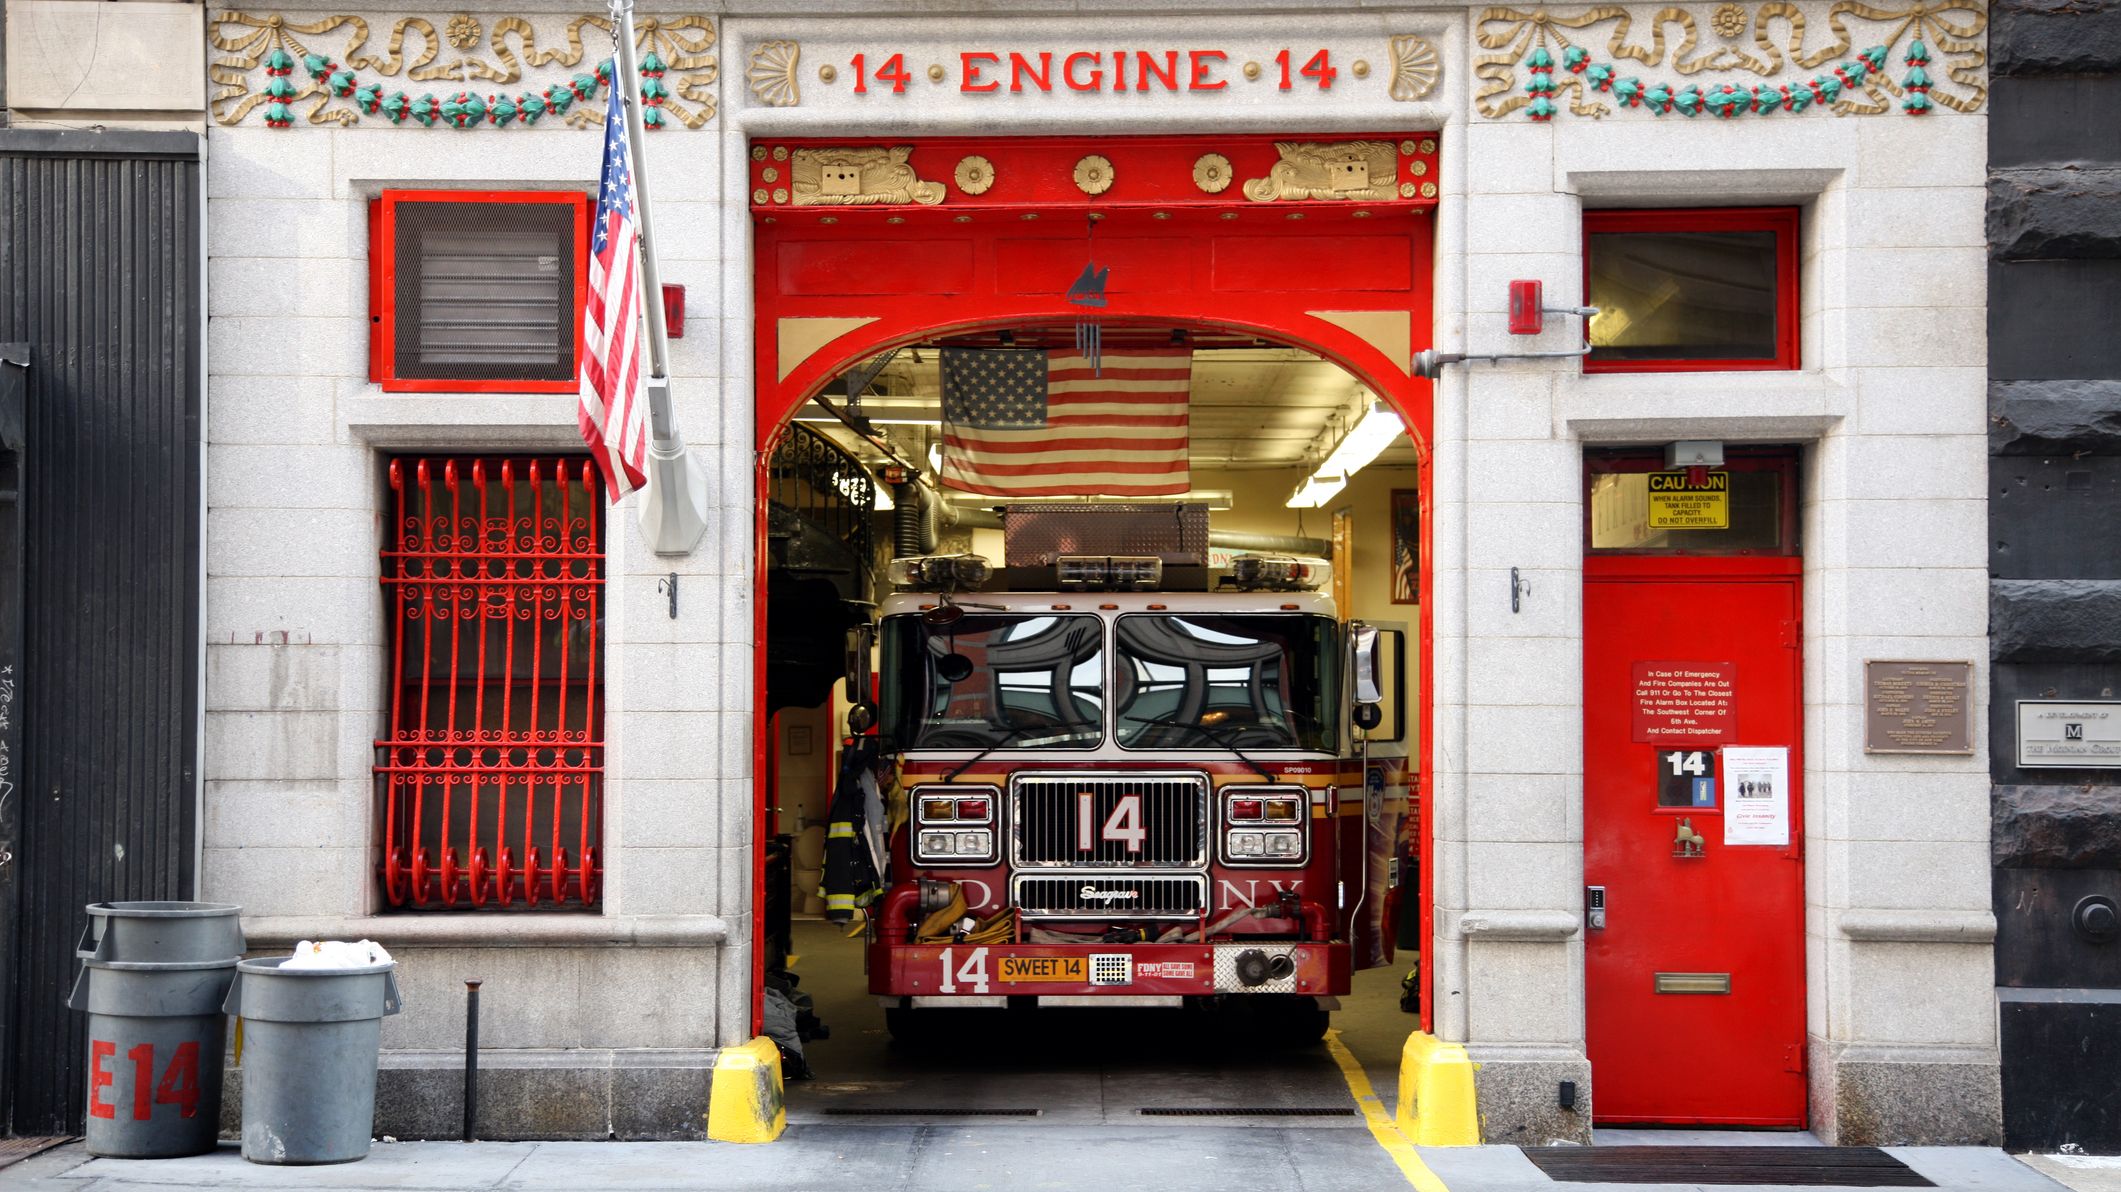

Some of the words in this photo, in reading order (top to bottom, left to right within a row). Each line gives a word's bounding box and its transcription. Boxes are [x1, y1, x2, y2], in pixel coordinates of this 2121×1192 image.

[851, 54, 910, 93] 14
[960, 50, 1228, 92] ENGINE
[1276, 49, 1337, 90] 14
[1650, 476, 1724, 490] CAUON
[1667, 680, 1702, 688] Companies
[2066, 724, 2083, 738] M
[1667, 751, 1705, 776] 14
[1078, 793, 1146, 852] 14
[1080, 886, 1139, 905] Seagrave
[939, 947, 989, 993] 14
[1004, 959, 1059, 976] SWEET
[1063, 959, 1081, 976] 14
[1137, 963, 1162, 972] FDNY
